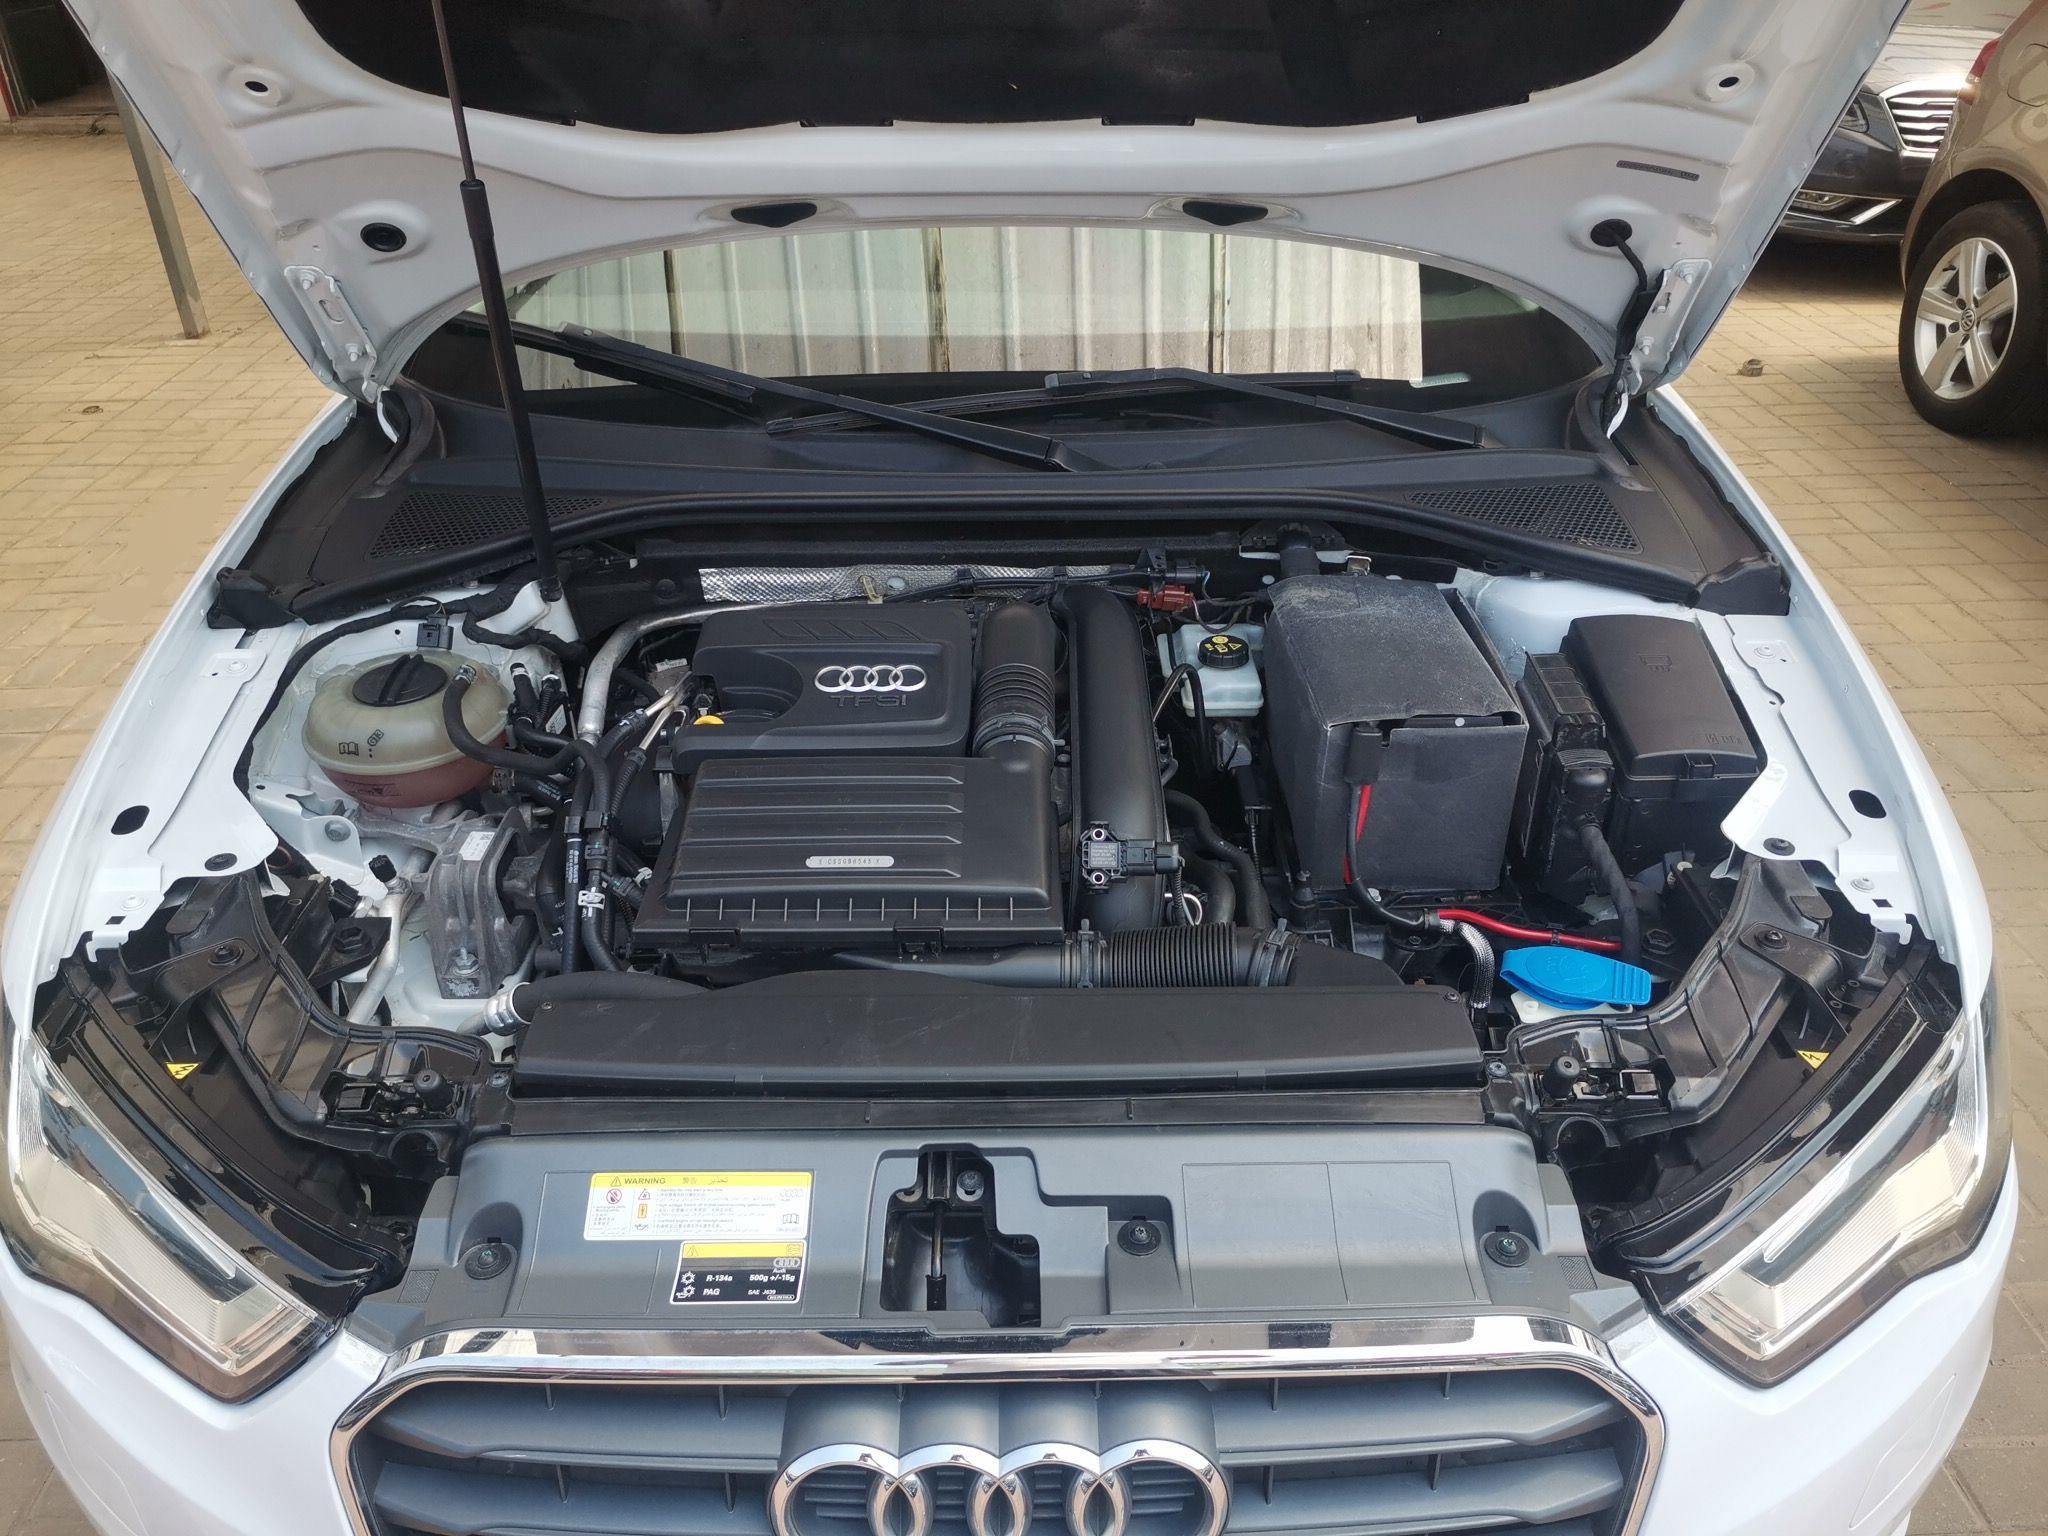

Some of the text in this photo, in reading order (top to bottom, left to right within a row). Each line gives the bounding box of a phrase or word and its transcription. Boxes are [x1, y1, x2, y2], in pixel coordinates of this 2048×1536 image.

[829, 694, 908, 708] TFSI
[624, 1177, 667, 1185] WARNING
[706, 1274, 733, 1282] R-134a
[749, 1274, 769, 1283] 500g
[702, 1288, 720, 1296] PAG
